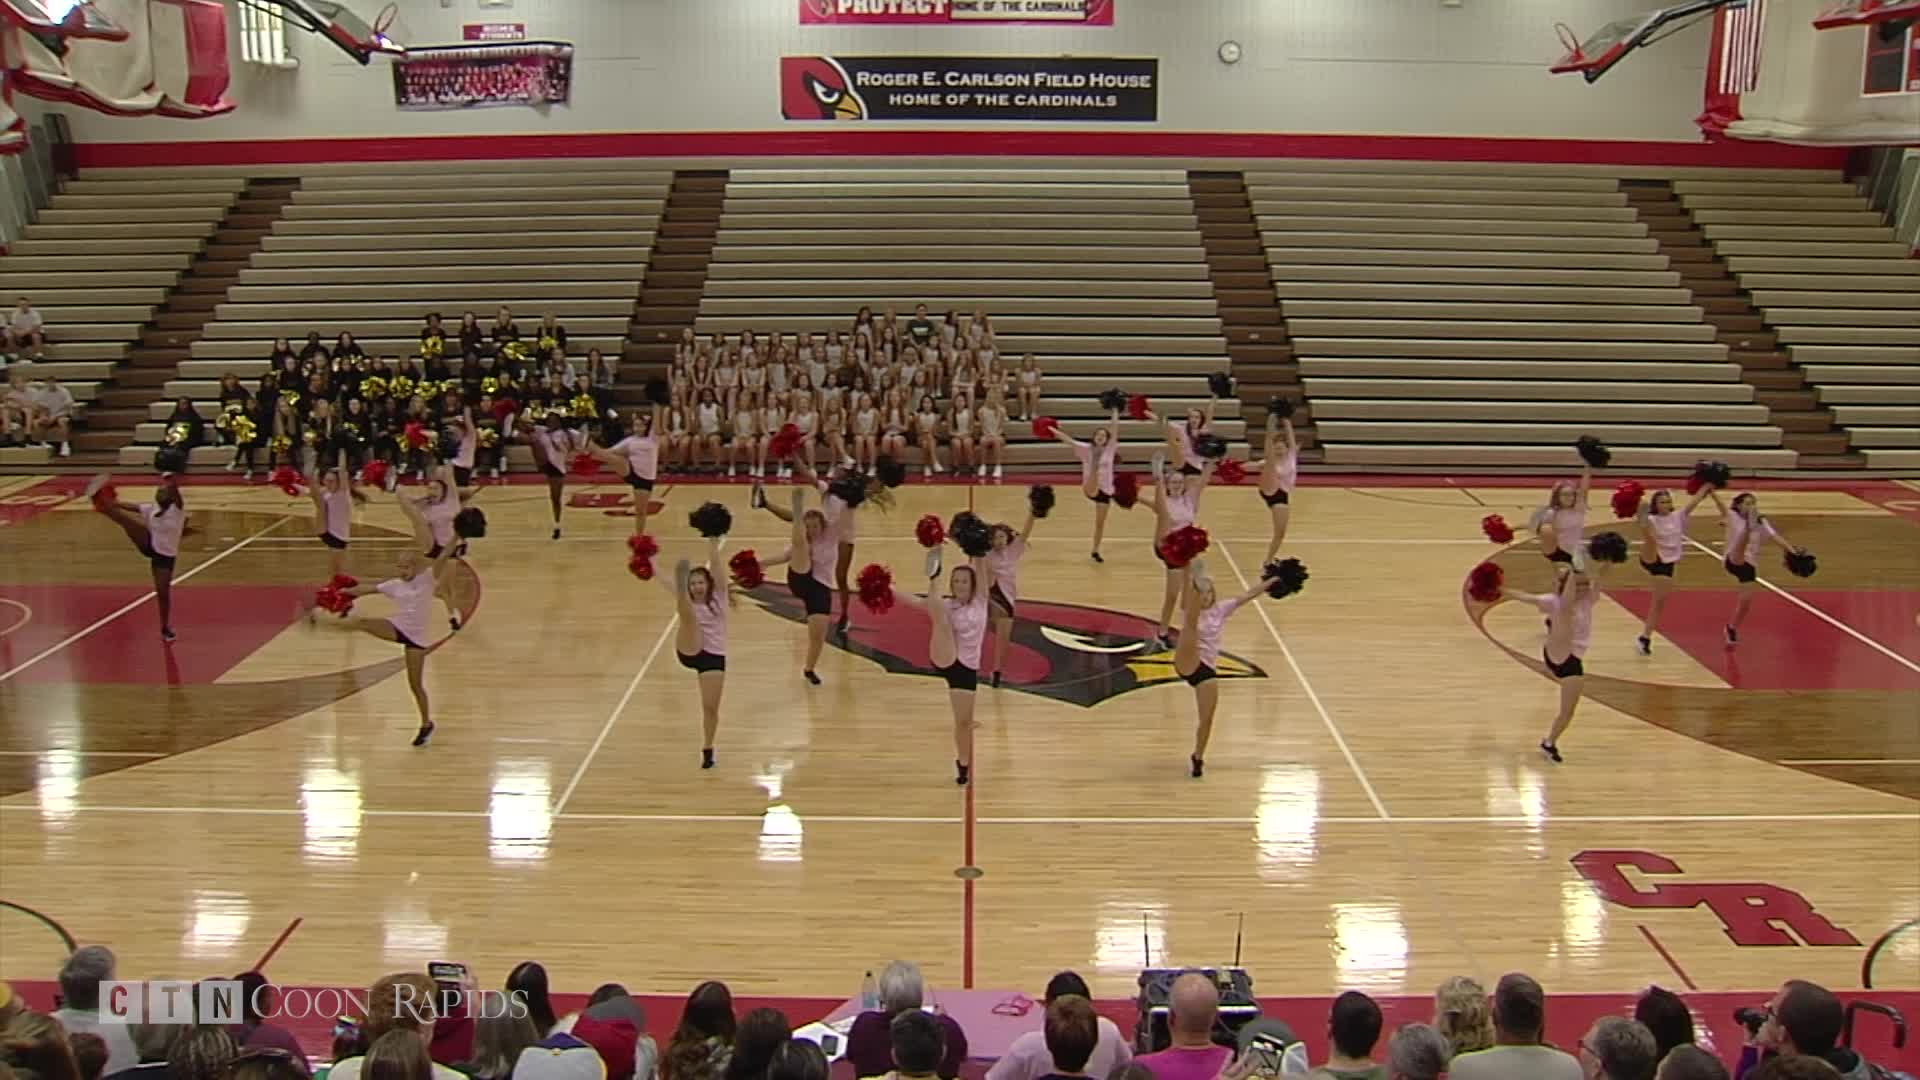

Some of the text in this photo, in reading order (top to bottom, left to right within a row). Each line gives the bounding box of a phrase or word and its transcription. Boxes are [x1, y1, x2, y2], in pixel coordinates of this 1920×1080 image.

[922, 71, 942, 87] E.
[889, 93, 1118, 107] HOME OF THE CARDINALS
